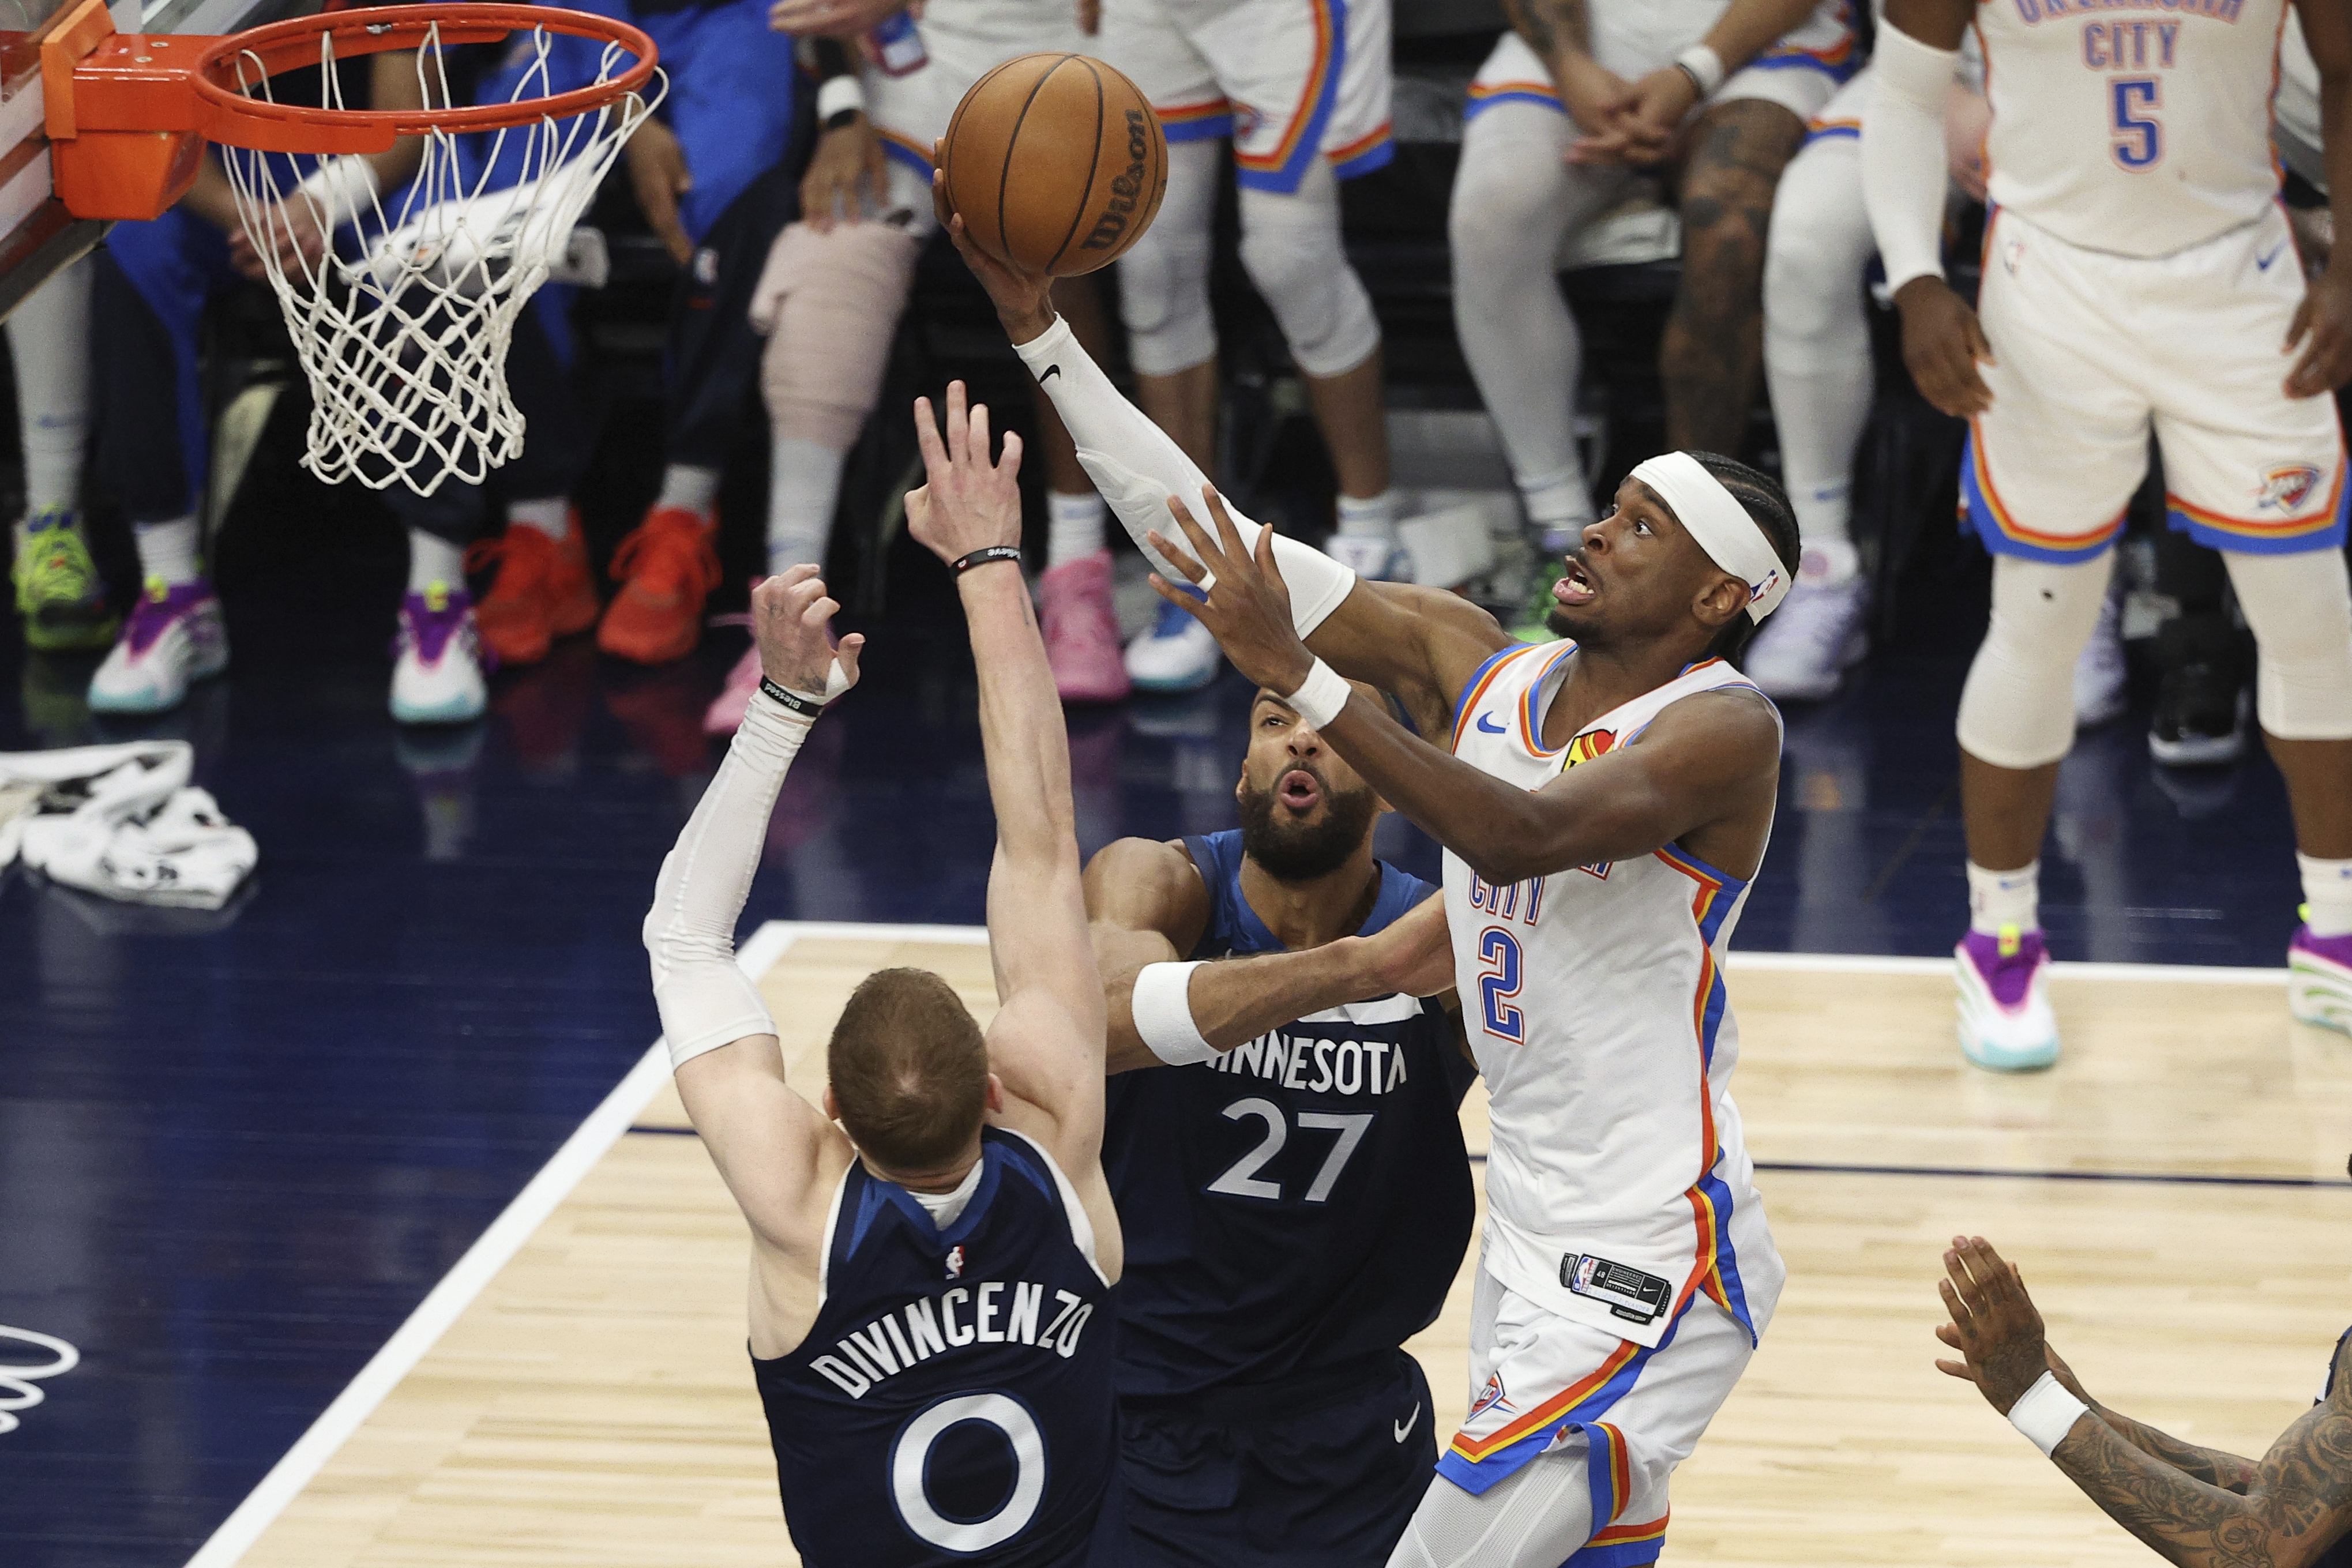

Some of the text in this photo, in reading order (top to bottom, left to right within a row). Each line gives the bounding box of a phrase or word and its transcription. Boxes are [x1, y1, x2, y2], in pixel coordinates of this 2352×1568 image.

[2082, 19, 2181, 70] CITY
[2107, 75, 2166, 173] 5
[1079, 109, 1147, 250] Wilson
[764, 683, 802, 710] Blessed
[1478, 925, 1524, 1045] 2
[1205, 1029, 1407, 1096] NNESOTA
[1207, 1097, 1374, 1202] 27
[809, 1281, 1094, 1400] DIVINCENZO
[893, 1393, 1046, 1552] 0
